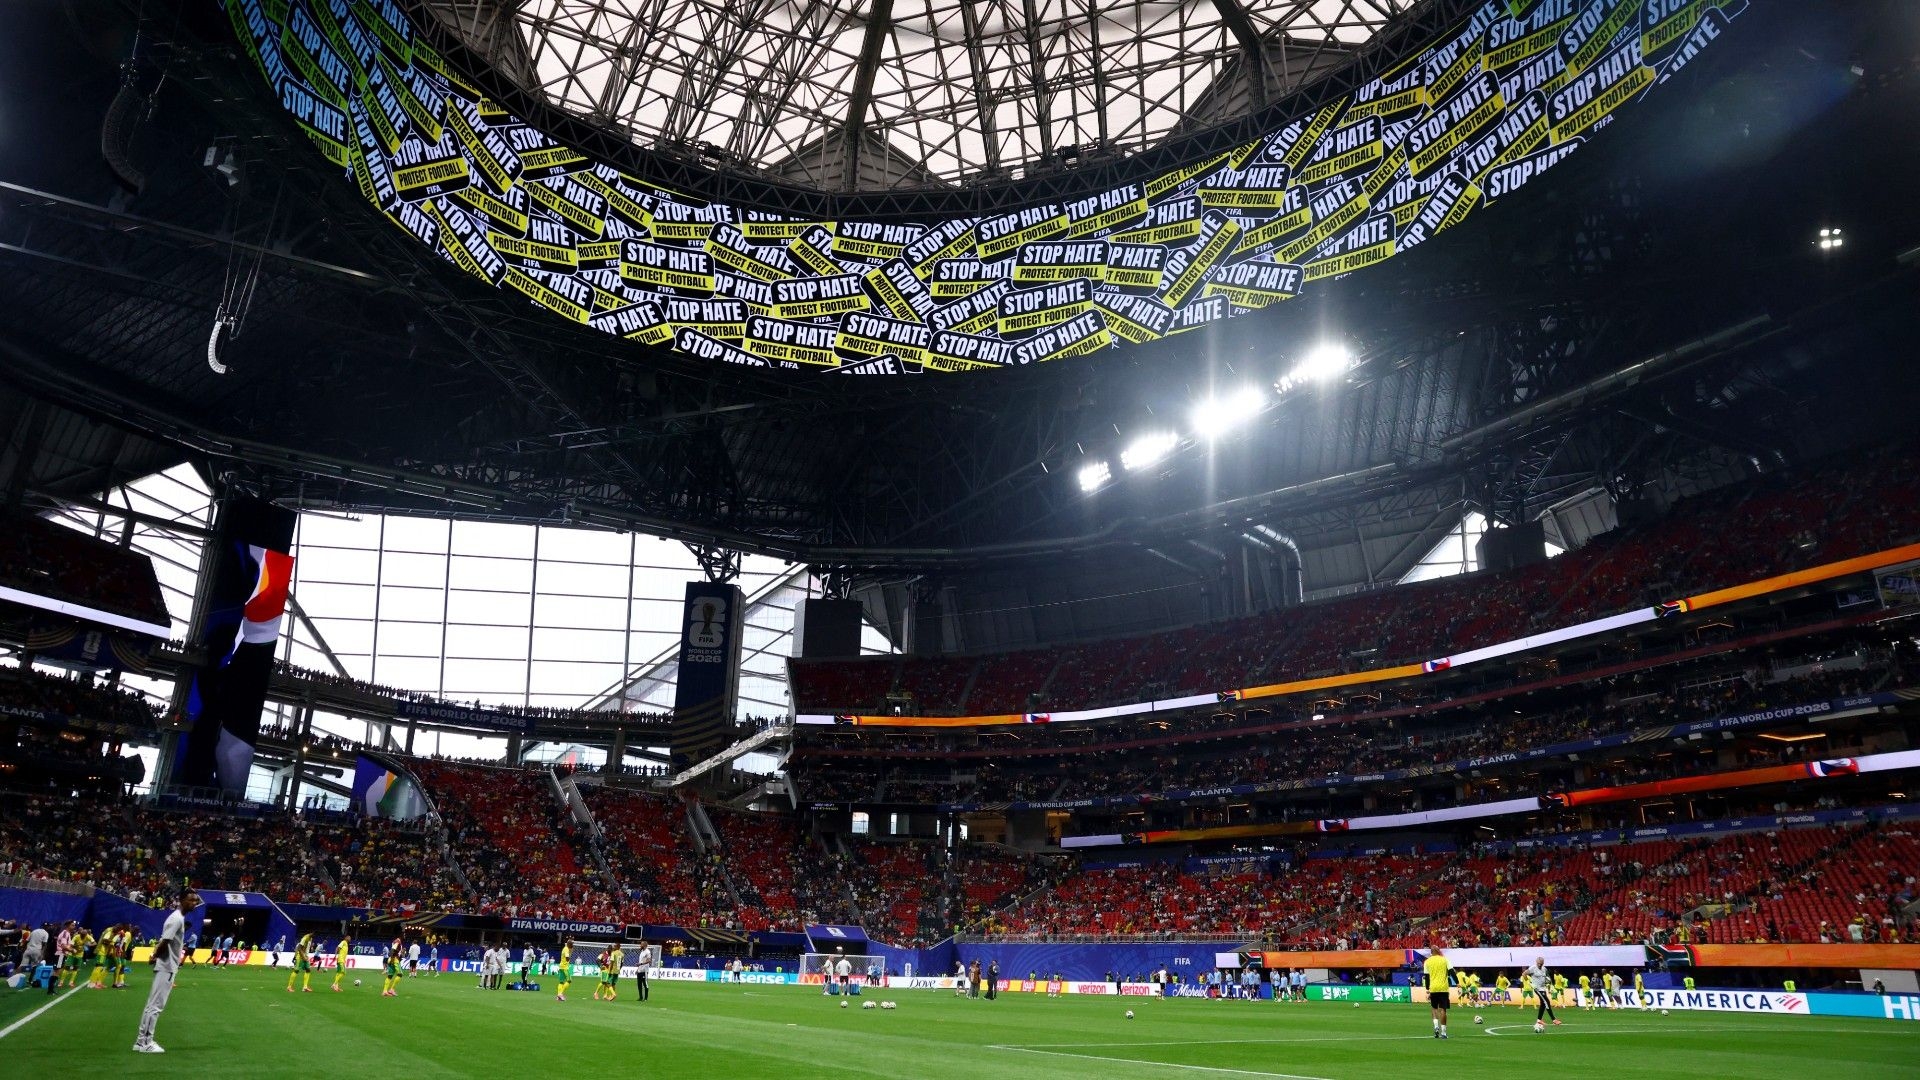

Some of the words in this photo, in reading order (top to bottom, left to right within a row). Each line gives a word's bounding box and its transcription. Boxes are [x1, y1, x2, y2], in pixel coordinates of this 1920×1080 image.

[1564, 4, 1603, 54] STOP
[1610, 25, 1631, 48] FIFA
[292, 8, 320, 55] STOP
[318, 44, 350, 94] HATE
[342, 16, 372, 67] HATE
[1418, 48, 1437, 64] FIFA
[1488, 43, 1526, 68] PROTECT
[435, 73, 450, 87] FIFA
[1553, 77, 1597, 120] STOP
[1598, 36, 1642, 91] HATE
[411, 72, 444, 120] HATE
[1377, 92, 1418, 114] FOOTBALL
[1558, 104, 1598, 141] PROTECT
[1600, 70, 1647, 113] FOOTBALL
[283, 82, 313, 121] STOP
[314, 100, 345, 141] HATE
[377, 83, 407, 134] HATE
[1409, 109, 1450, 153] STOP
[1452, 76, 1493, 123] HATE
[1455, 101, 1498, 137] FOOTBALL
[1498, 96, 1542, 147] HATE
[1593, 114, 1614, 133] FIFA
[456, 97, 489, 133] STOP
[483, 130, 520, 174] HATE
[510, 127, 544, 151] STOP
[1268, 120, 1303, 160] STOP
[1336, 119, 1375, 154] HATE
[1334, 147, 1376, 171] FOOTBALL
[1451, 141, 1469, 157] FIFA
[366, 151, 395, 203] HATE
[429, 164, 463, 180] FOOTBALL
[549, 166, 566, 175] FIFA
[1245, 167, 1285, 188] HATE
[1326, 174, 1344, 185] FIFA
[1490, 158, 1532, 197] STOP
[427, 185, 442, 194] FIFA
[654, 190, 672, 200] FIFA
[1099, 184, 1139, 206] HATE
[1177, 178, 1196, 190] FIFA
[564, 180, 604, 216] HATE
[1237, 193, 1277, 205] FOOTBALL
[1313, 183, 1356, 220] HATE
[1421, 180, 1463, 229] HATE
[399, 201, 437, 246] HATE
[474, 208, 490, 223] FIFA
[482, 198, 520, 227] FOOTBALL
[546, 209, 564, 222] FIFA
[558, 200, 597, 230] FOOTBALL
[981, 216, 1019, 241] STOP
[1020, 204, 1060, 229] HATE
[1100, 204, 1141, 224] FOOTBALL
[1157, 199, 1195, 225] HATE
[532, 218, 570, 246] HATE
[842, 221, 882, 241] STOP
[883, 224, 923, 244] HATE
[984, 236, 1021, 254] PROTECT
[1021, 220, 1062, 243] FOOTBALL
[1094, 227, 1112, 238] FIFA
[1153, 222, 1195, 240] FOOTBALL
[1347, 218, 1388, 250] HATE
[464, 229, 503, 278] HATE
[494, 236, 529, 254] PROTECT
[530, 245, 571, 263] FOOTBALL
[627, 242, 667, 266] STOP
[669, 249, 708, 273] HATE
[908, 231, 944, 263] STOP
[1024, 245, 1063, 264] STOP
[1064, 244, 1104, 263] HATE
[1121, 249, 1160, 268] HATE
[523, 259, 541, 269] FIFA
[755, 246, 794, 273] HATE
[866, 257, 884, 265] FIFA
[940, 261, 978, 279] STOP
[627, 266, 663, 282] PROTECT
[666, 273, 708, 289] FOOTBALL
[886, 261, 922, 296] STOP
[1020, 267, 1057, 278] PROTECT
[1057, 266, 1099, 278] FOOTBALL
[1114, 270, 1154, 284] FOOTBALL
[1216, 264, 1255, 285] STOP
[1256, 266, 1299, 291] HATE
[549, 272, 590, 306] HATE
[657, 286, 676, 295] FIFA
[778, 280, 818, 301] STOP
[820, 276, 860, 297] HATE
[1004, 293, 1044, 315] STOP
[1046, 282, 1085, 303] HATE
[1103, 285, 1120, 293] FIFA
[702, 302, 743, 321] HATE
[780, 304, 818, 317] PROTECT
[820, 298, 863, 312] FOOTBALL
[932, 299, 975, 330] STOP
[814, 316, 832, 324] FIFA
[850, 315, 888, 338] STOP
[889, 322, 930, 347] HATE
[752, 319, 794, 342] STOP
[795, 326, 835, 348] HATE
[842, 336, 879, 354] PROTECT
[1016, 332, 1057, 365] STOP
[1059, 312, 1099, 345] HATE
[681, 331, 722, 364] STOP
[750, 341, 788, 358] PROTECT
[790, 348, 834, 364] FOOTBALL
[936, 334, 976, 358] STOP
[780, 360, 799, 370] FIFA
[687, 655, 722, 663] 2026
[405, 704, 427, 715] FIFA
[430, 708, 468, 721] WORLD
[469, 712, 490, 723] CUP
[491, 715, 528, 728] 2026
[1719, 717, 1739, 727] FIFA
[1740, 711, 1773, 725] WORLD
[1774, 708, 1793, 718] CUP
[1795, 702, 1831, 715] 2026
[1189, 787, 1233, 797] ATLANTA
[1028, 801, 1042, 809] FIFA
[1042, 800, 1063, 808] WORLD
[511, 919, 532, 929] FIFA
[534, 921, 568, 931] WORLD
[569, 924, 588, 932] CUP
[1175, 957, 1191, 965] FIFA
[721, 970, 785, 985] Hsense
[909, 978, 936, 989] Dove
[1078, 983, 1107, 994] verizon
[1121, 984, 1150, 995] verizon
[1672, 992, 1773, 1010] AMERICA
